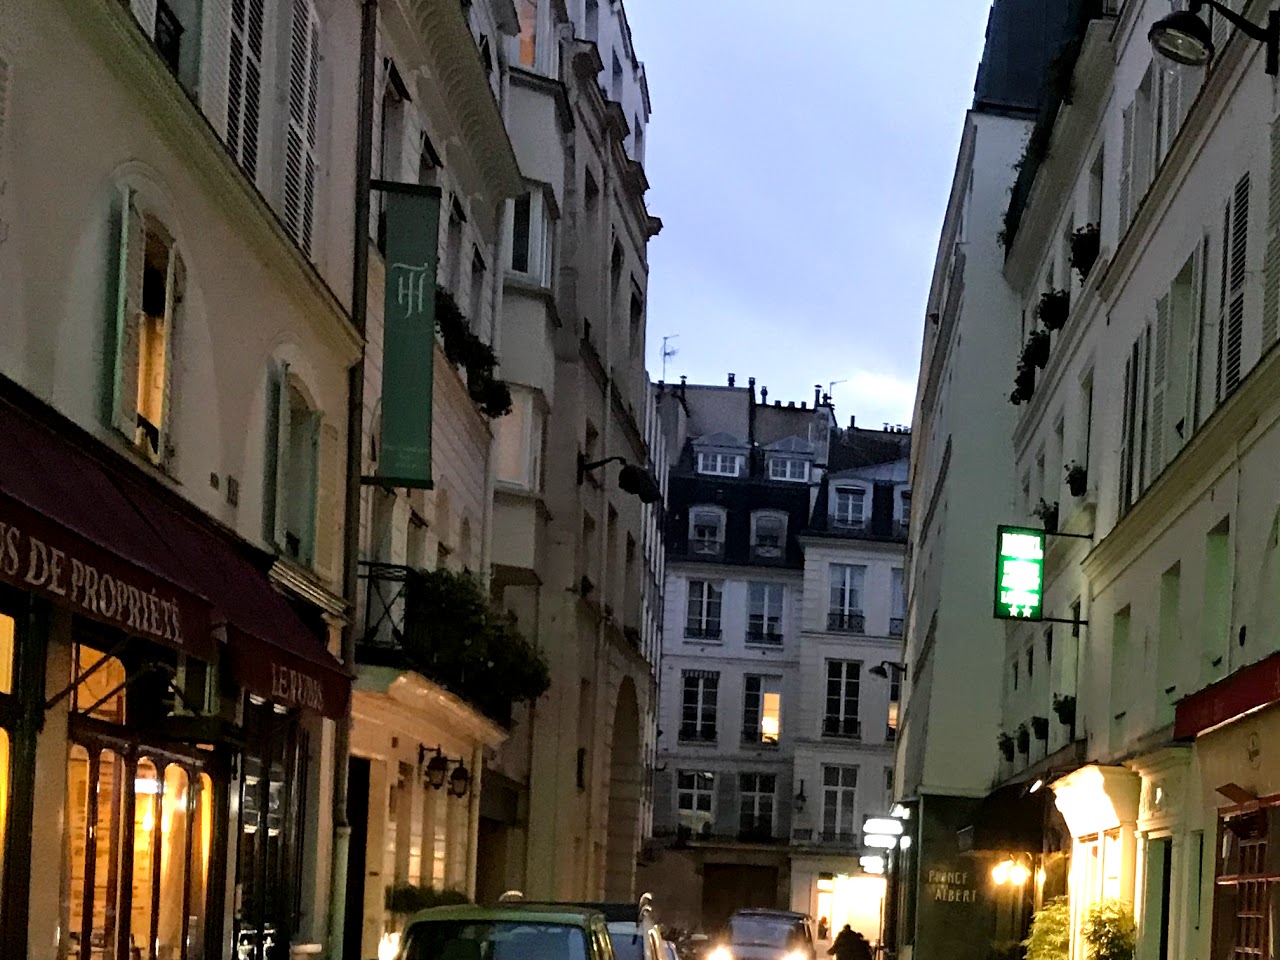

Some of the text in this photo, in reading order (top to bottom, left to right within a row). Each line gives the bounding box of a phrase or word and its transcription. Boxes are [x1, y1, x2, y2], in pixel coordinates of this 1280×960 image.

[0, 521, 20, 576] S
[24, 536, 66, 596] DE
[271, 662, 289, 698] LE
[935, 888, 977, 903] ALBERT
